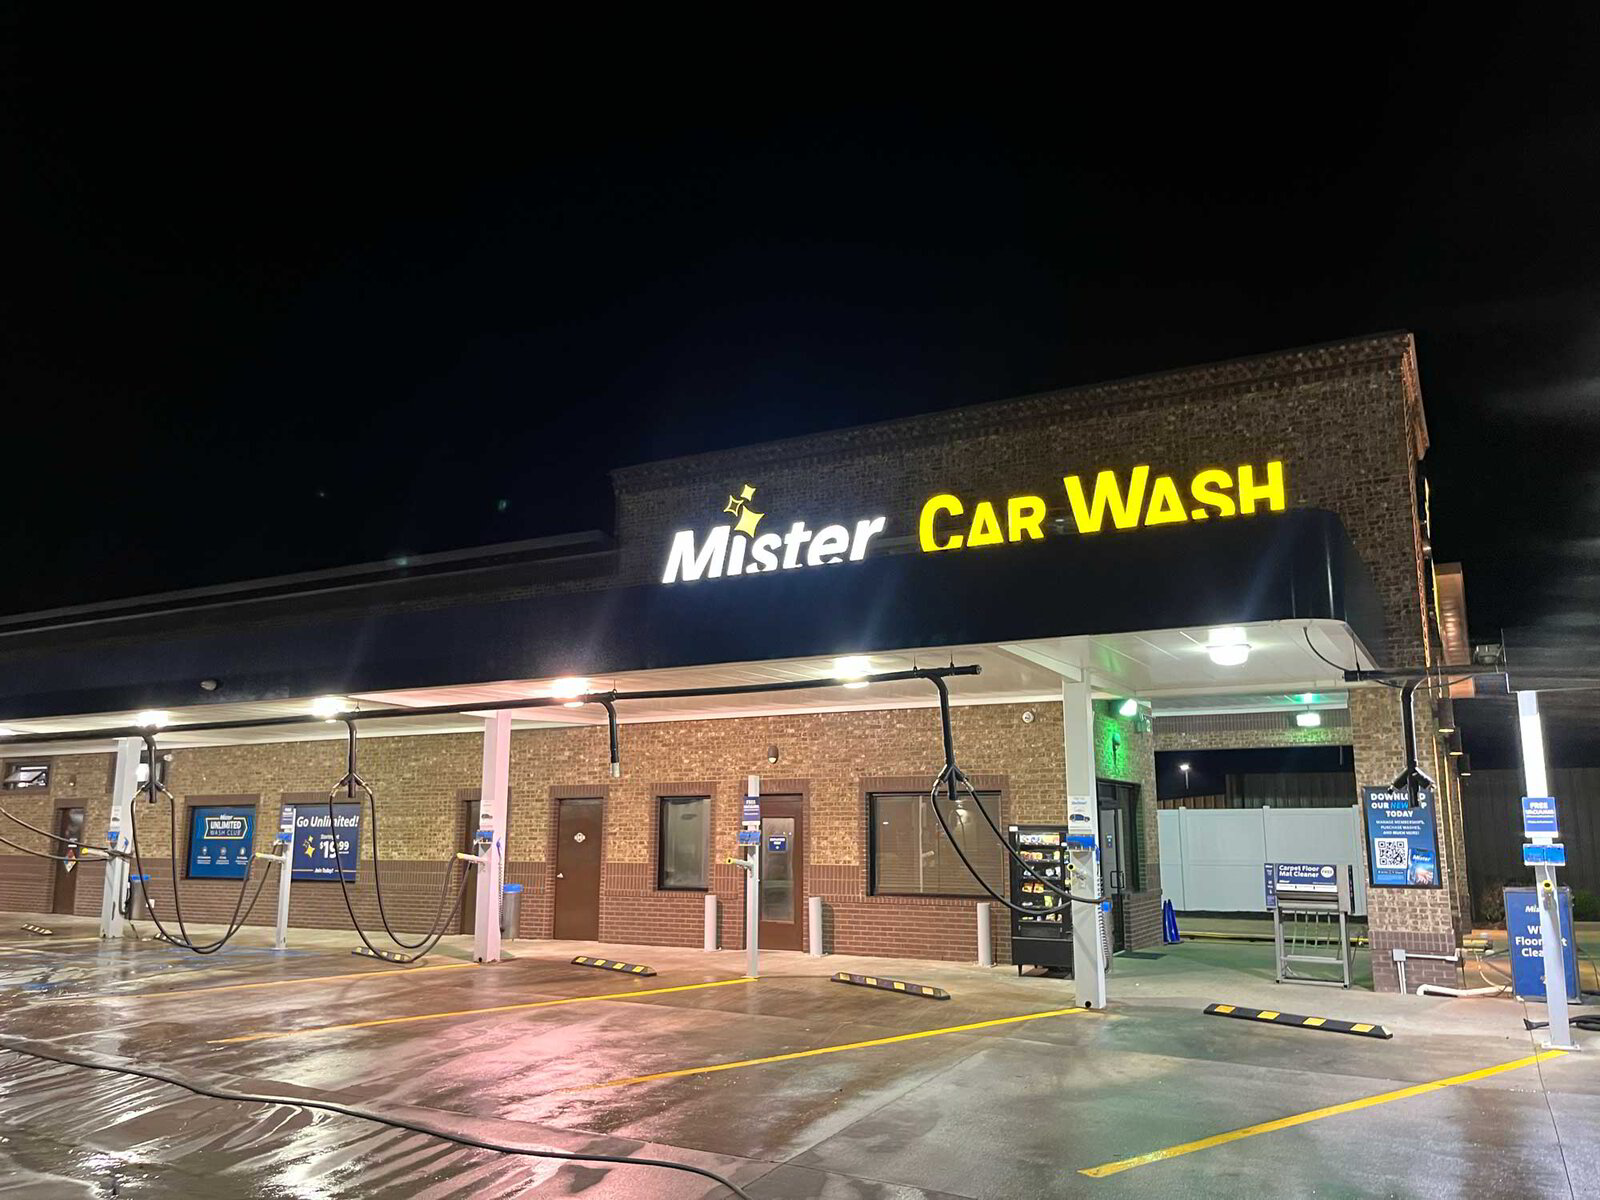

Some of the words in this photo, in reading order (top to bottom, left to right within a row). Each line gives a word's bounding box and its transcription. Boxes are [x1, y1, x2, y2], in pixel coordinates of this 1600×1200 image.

[662, 516, 887, 584] Mister
[919, 494, 1047, 552] CAR
[1063, 461, 1285, 534] WASH
[1370, 793, 1426, 801] DOWNLOD
[1529, 801, 1549, 809] FREE
[210, 820, 242, 830] UNLIMITED
[297, 816, 309, 827] Go
[1412, 854, 1431, 862] Mister
[1279, 864, 1300, 873] Carpet
[1293, 870, 1319, 878] Cleaner
